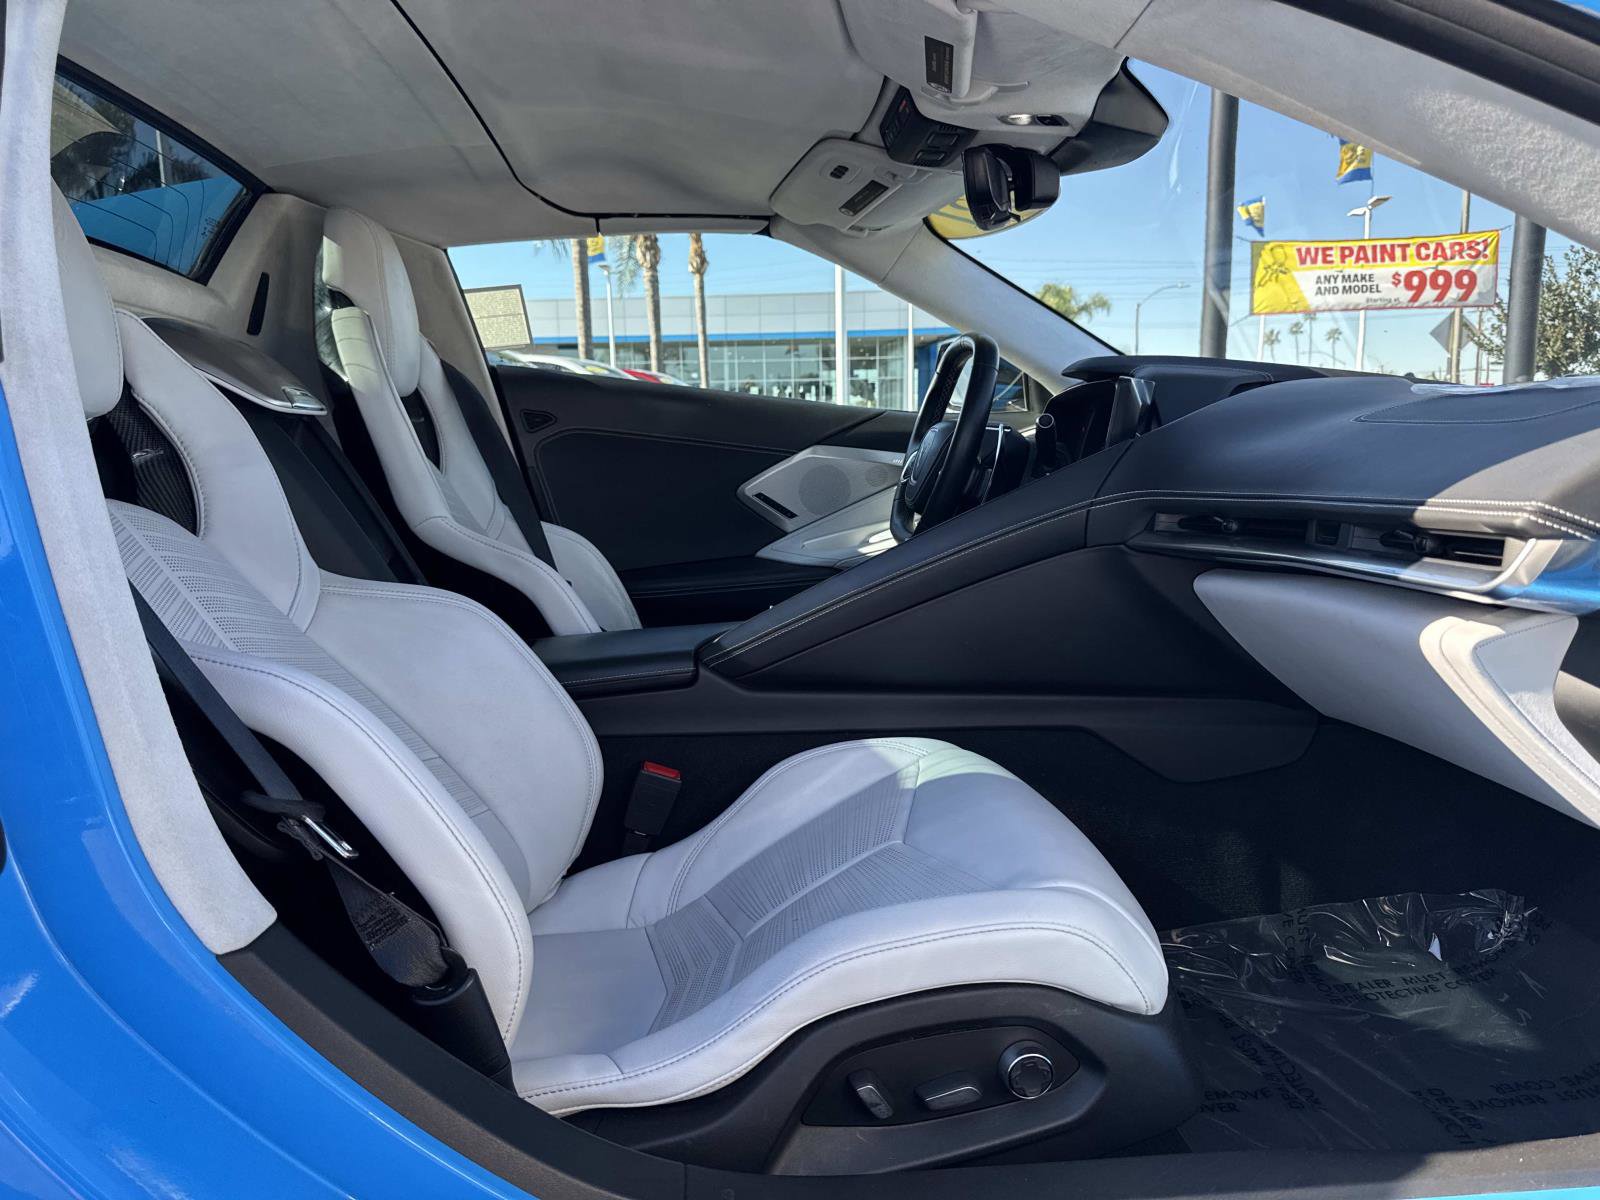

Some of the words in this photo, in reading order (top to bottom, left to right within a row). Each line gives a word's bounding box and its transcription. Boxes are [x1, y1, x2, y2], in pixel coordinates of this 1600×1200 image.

[1296, 246, 1334, 266] WE
[1340, 243, 1410, 264] PAINT
[1415, 239, 1489, 262] CARS!
[1315, 274, 1339, 286] ANY
[1341, 273, 1375, 284] MAKE
[1392, 269, 1478, 303] $999
[1315, 286, 1340, 296] AND
[1341, 284, 1382, 295] MODEL
[1332, 978, 1395, 994] DEALER
[1400, 971, 1446, 986] MUST
[1204, 1086, 1273, 1101] EMOVE
